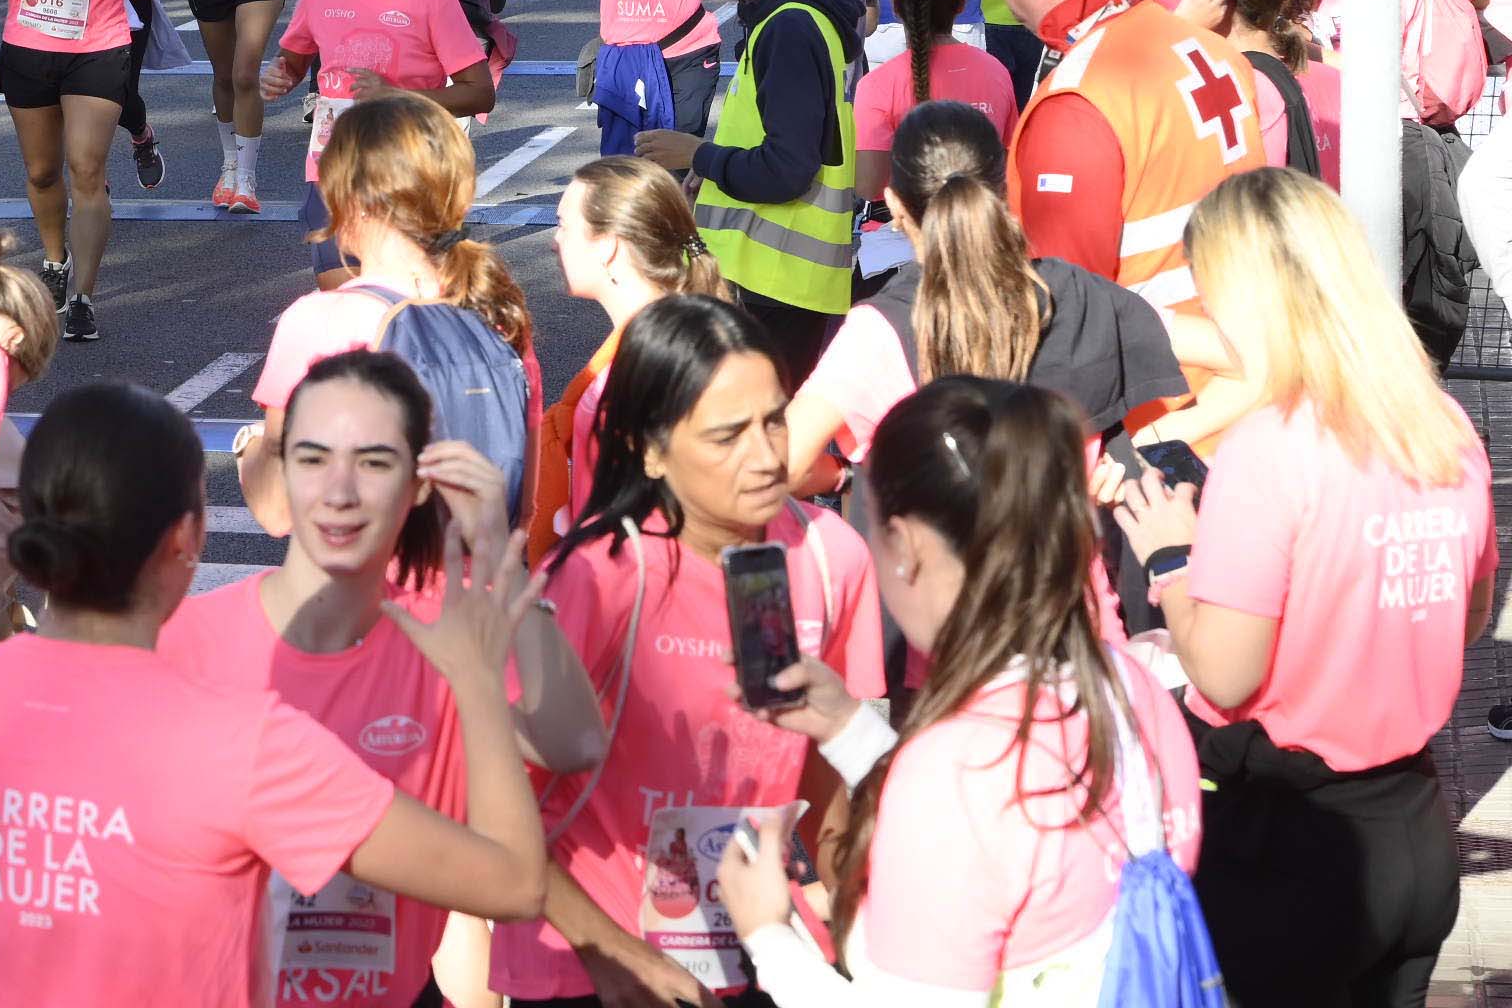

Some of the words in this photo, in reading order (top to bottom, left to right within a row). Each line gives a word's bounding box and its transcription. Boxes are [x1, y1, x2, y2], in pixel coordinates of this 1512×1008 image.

[617, 0, 666, 17] SUMA
[1364, 507, 1469, 548] CARRERA
[1386, 543, 1420, 577] DE
[1424, 541, 1453, 572] LA
[1378, 572, 1458, 610] MUJER
[44, 834, 94, 876] LA
